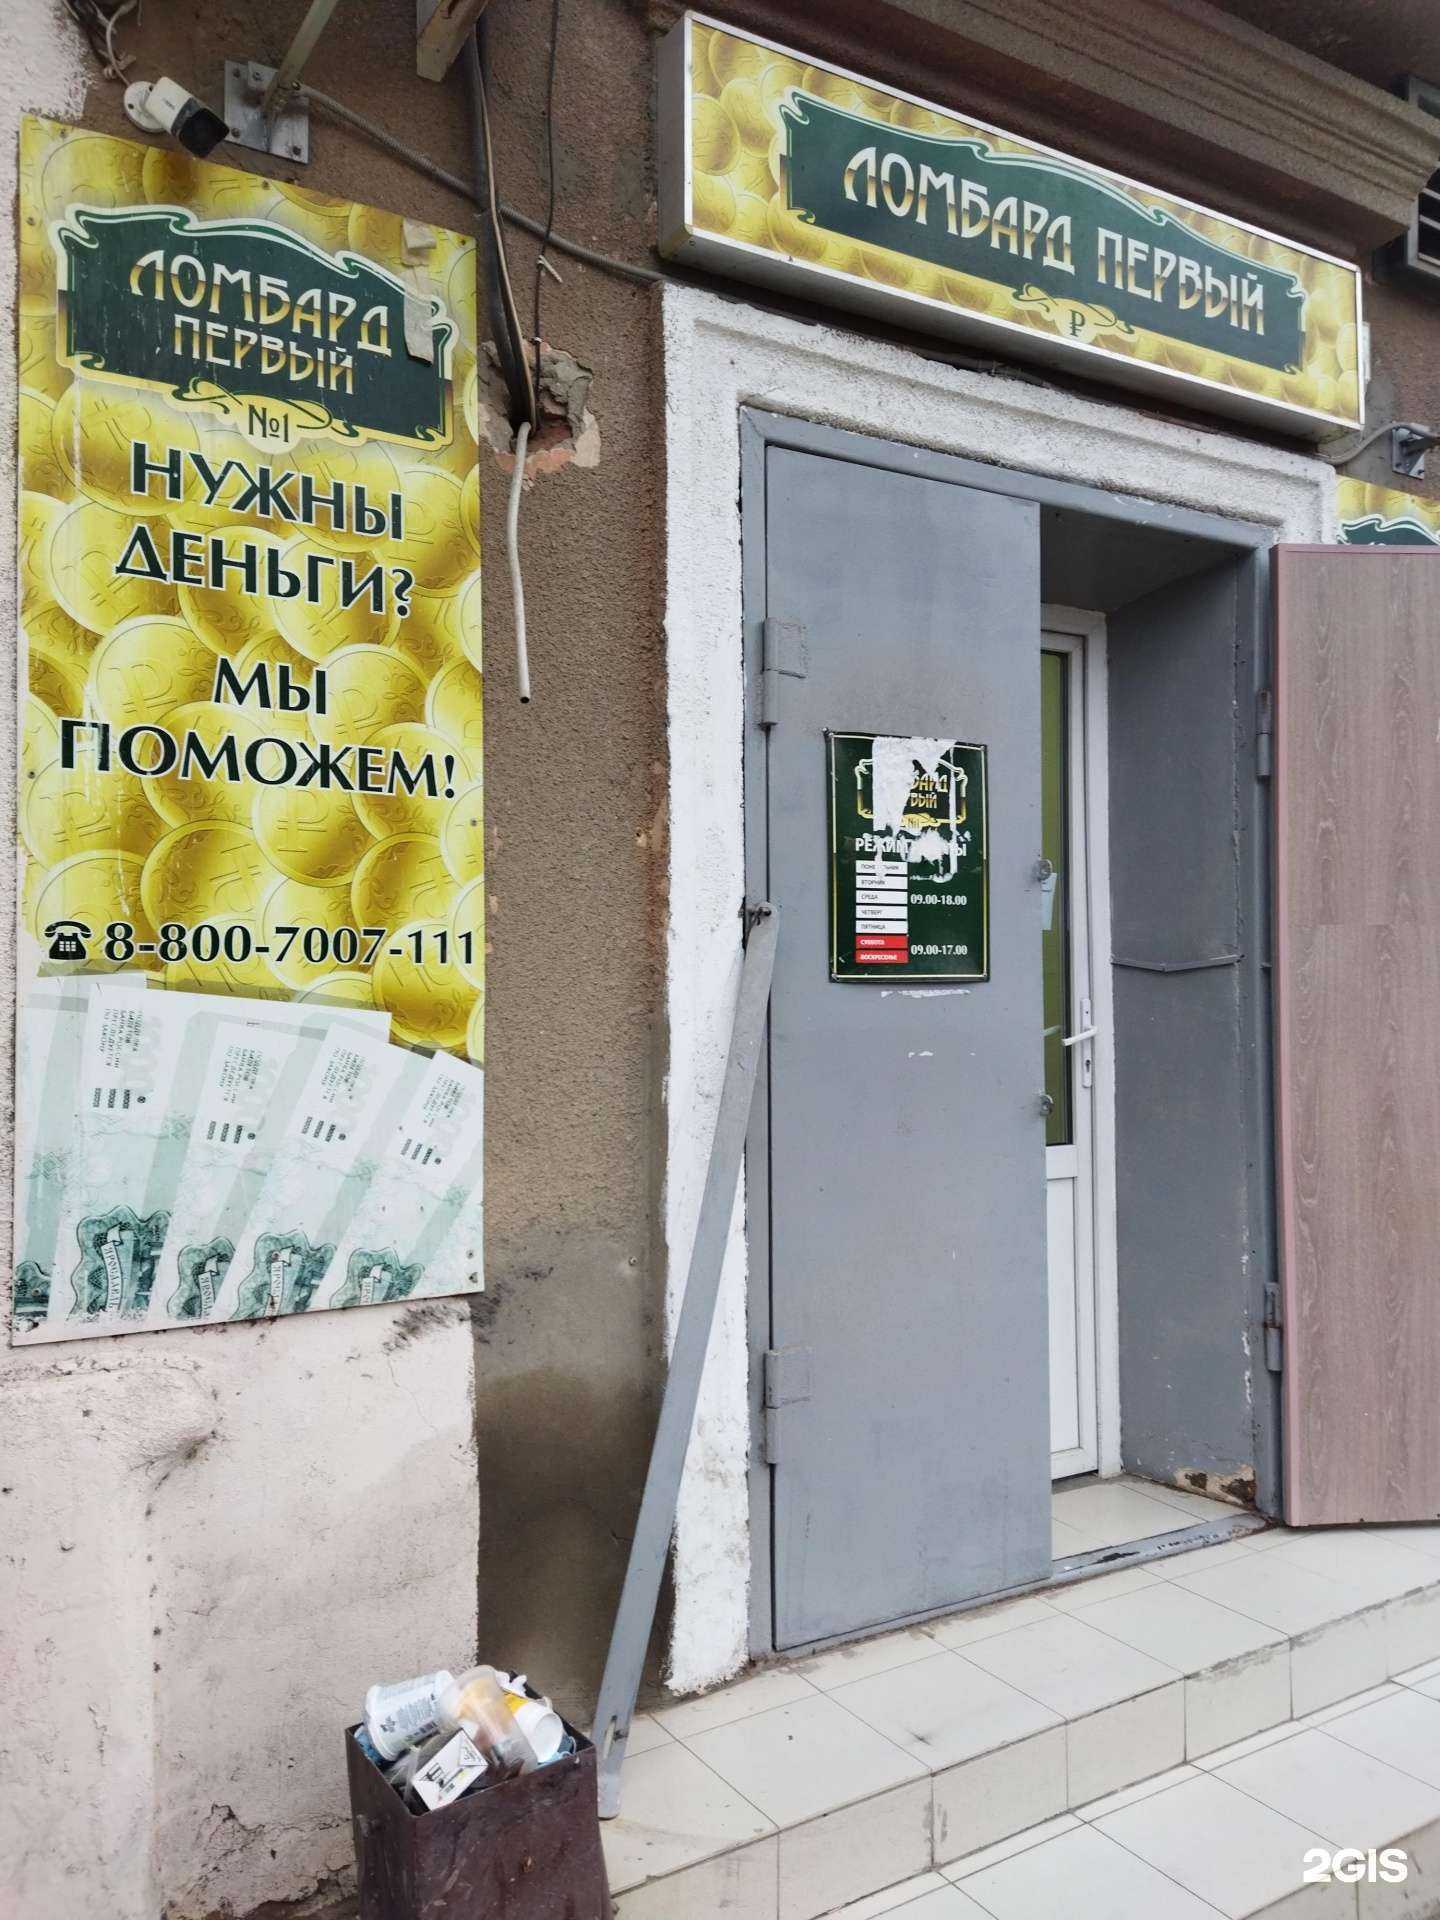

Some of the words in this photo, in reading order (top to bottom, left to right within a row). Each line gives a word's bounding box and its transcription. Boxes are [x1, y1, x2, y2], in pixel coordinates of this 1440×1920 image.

[843, 147, 1075, 275] ЛОМБАРД
[1097, 227, 1265, 336] ПЕРВЫЙ
[129, 250, 391, 358] ЛОМБАРД
[174, 314, 353, 394] ПЕРВЫЙ
[248, 404, 289, 442] №1
[132, 440, 403, 541] НУЖНЫ
[115, 524, 414, 618] ДЕНЬГИ?
[214, 657, 326, 715] МЫ
[60, 719, 456, 799] ПОМОЖЕМ!
[910, 893, 968, 906] 09.00-18.00
[105, 923, 474, 965] 8-800-7007-111
[910, 944, 969, 956] 09.00-17.00
